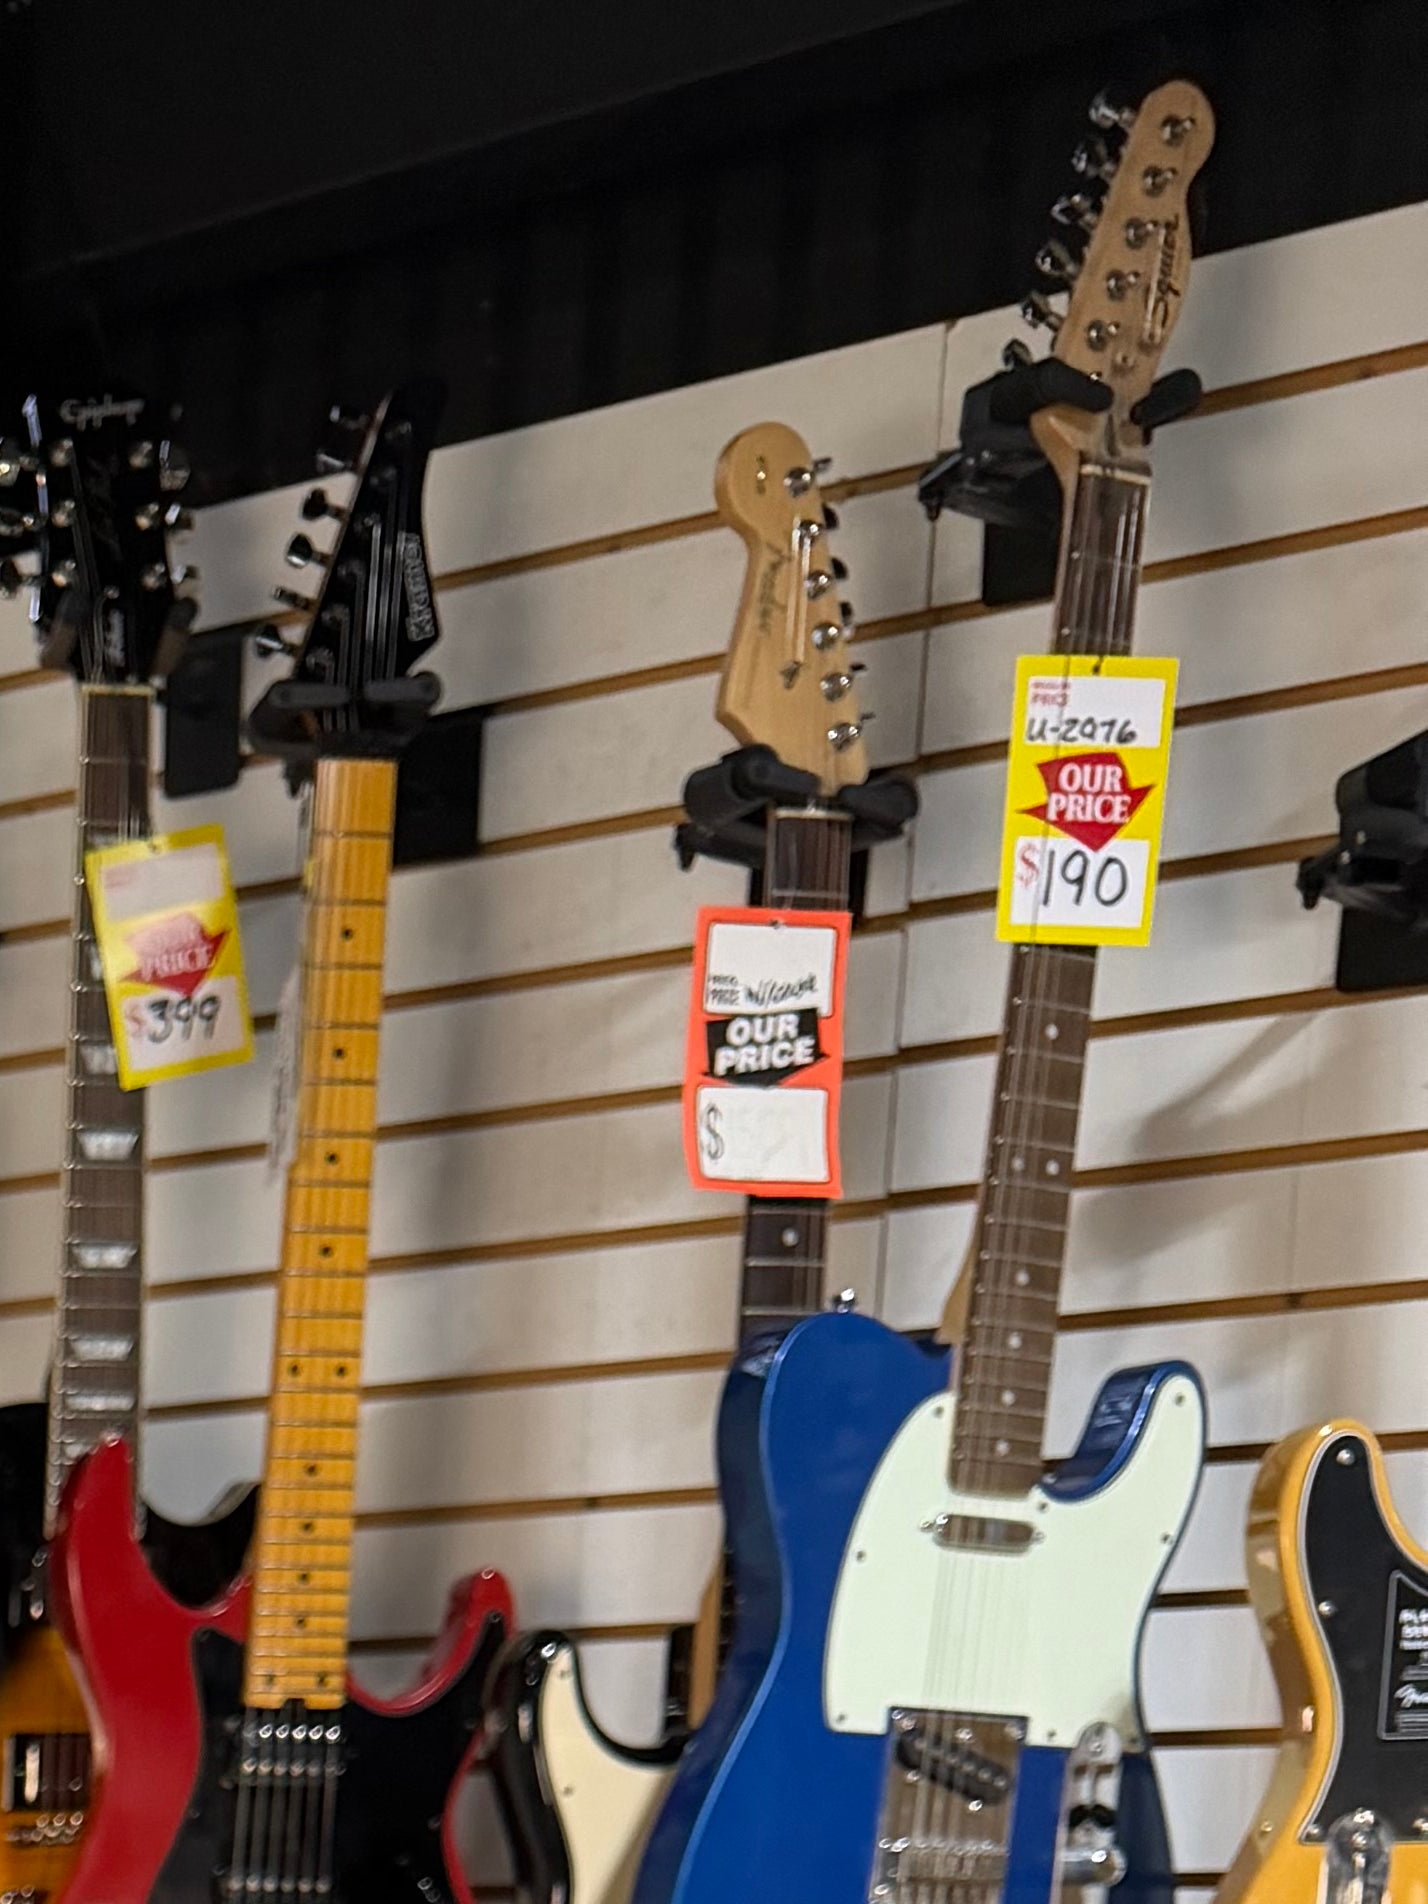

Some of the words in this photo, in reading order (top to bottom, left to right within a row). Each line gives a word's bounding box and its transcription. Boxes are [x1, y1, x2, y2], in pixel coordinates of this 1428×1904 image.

[1057, 762, 1124, 793] OUR
[1046, 792, 1132, 824] PRICE
[725, 1013, 800, 1046] OUR
[713, 1036, 817, 1078] PRICE
